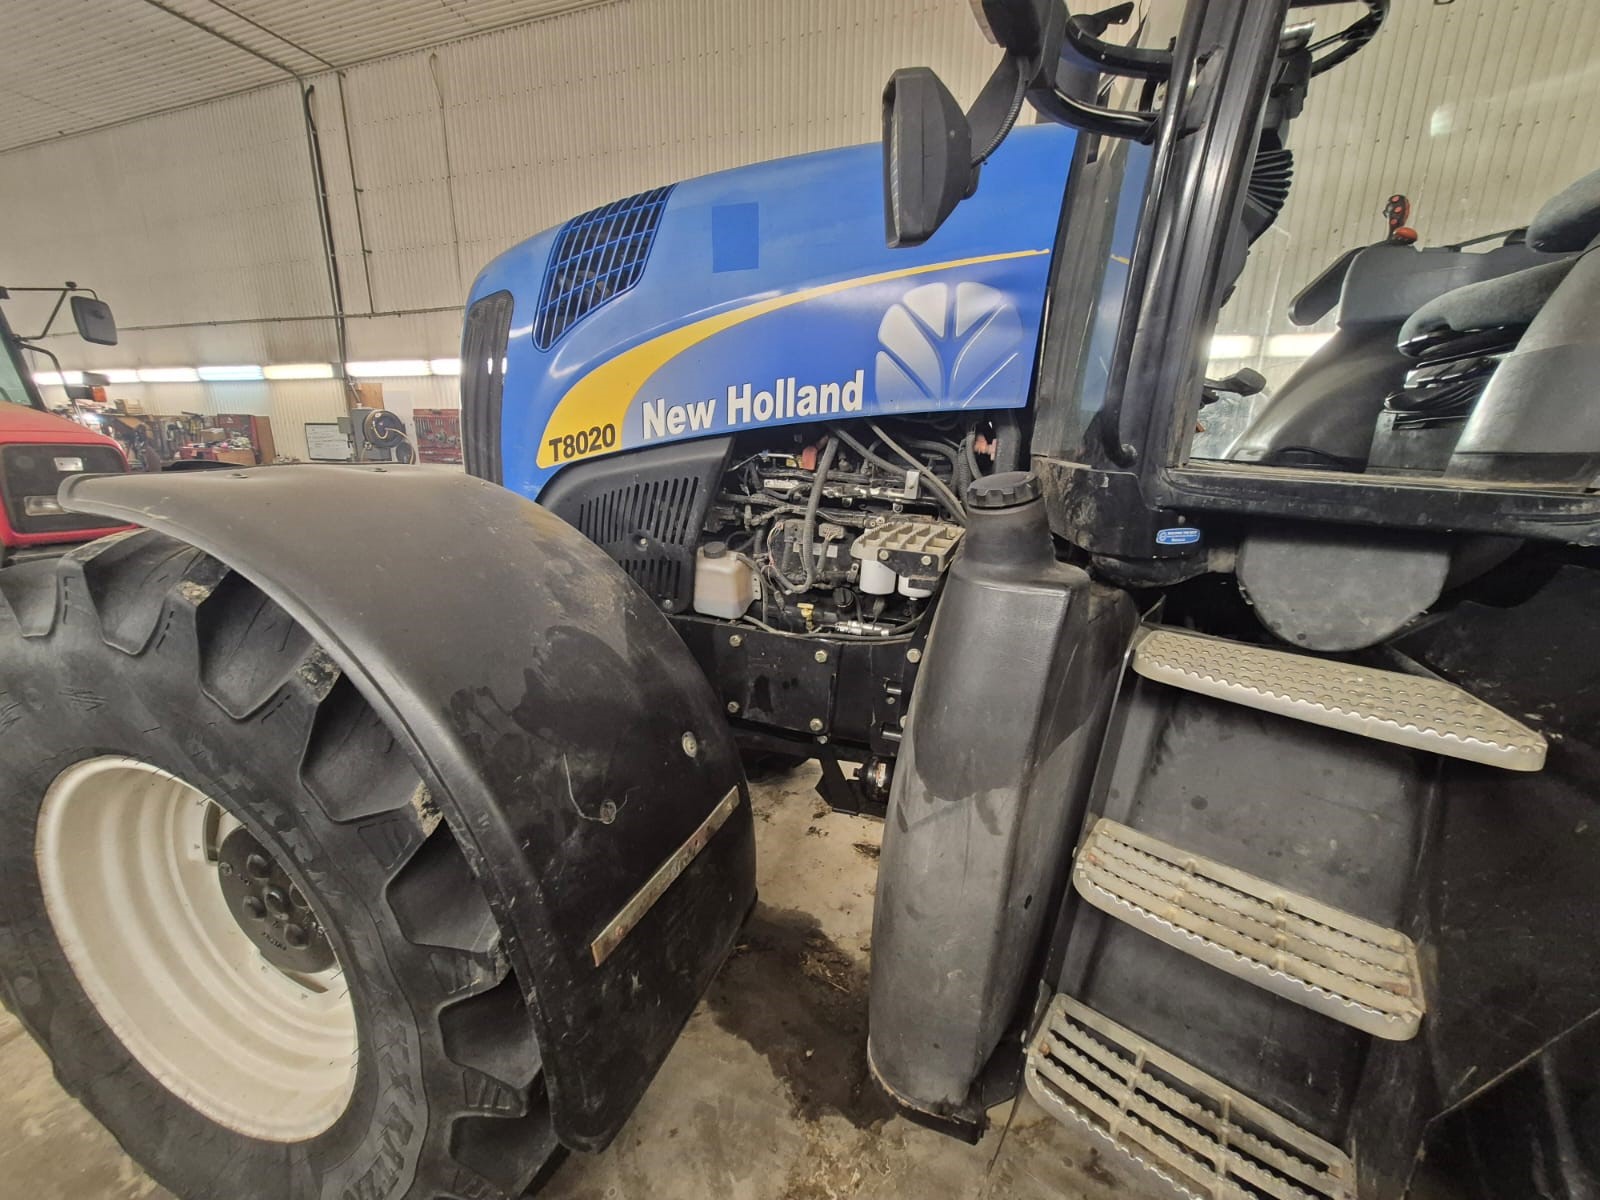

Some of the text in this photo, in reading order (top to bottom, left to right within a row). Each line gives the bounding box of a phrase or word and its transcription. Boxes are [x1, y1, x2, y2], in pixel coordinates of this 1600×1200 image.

[643, 370, 865, 439] New Holland
[549, 423, 616, 462] T8020
